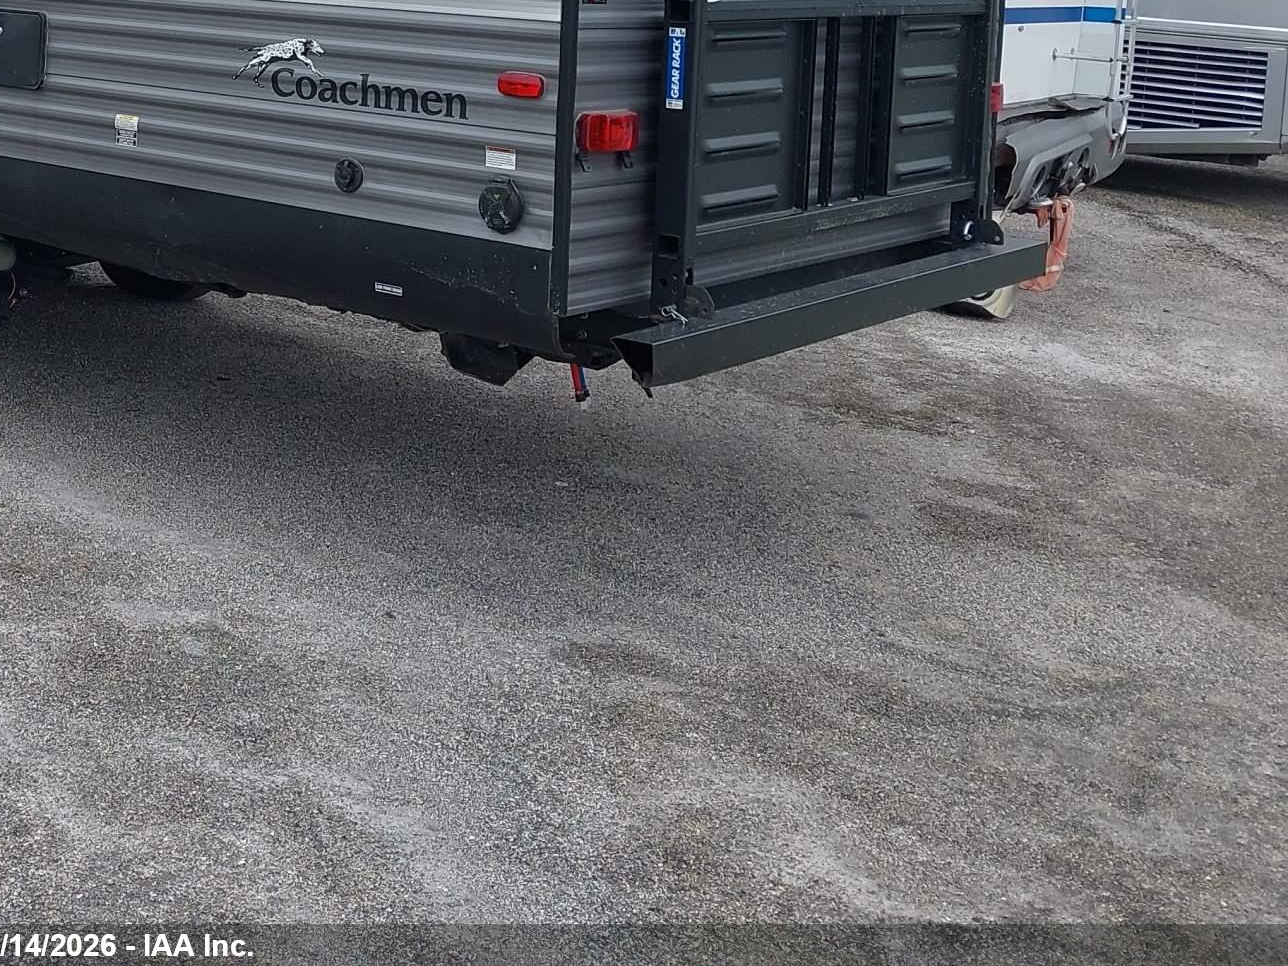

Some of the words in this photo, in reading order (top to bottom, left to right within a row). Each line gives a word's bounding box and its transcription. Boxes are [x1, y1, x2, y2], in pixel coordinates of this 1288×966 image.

[672, 37, 681, 68] RACK
[271, 67, 469, 120] Coachmen
[670, 68, 680, 99] GEAR
